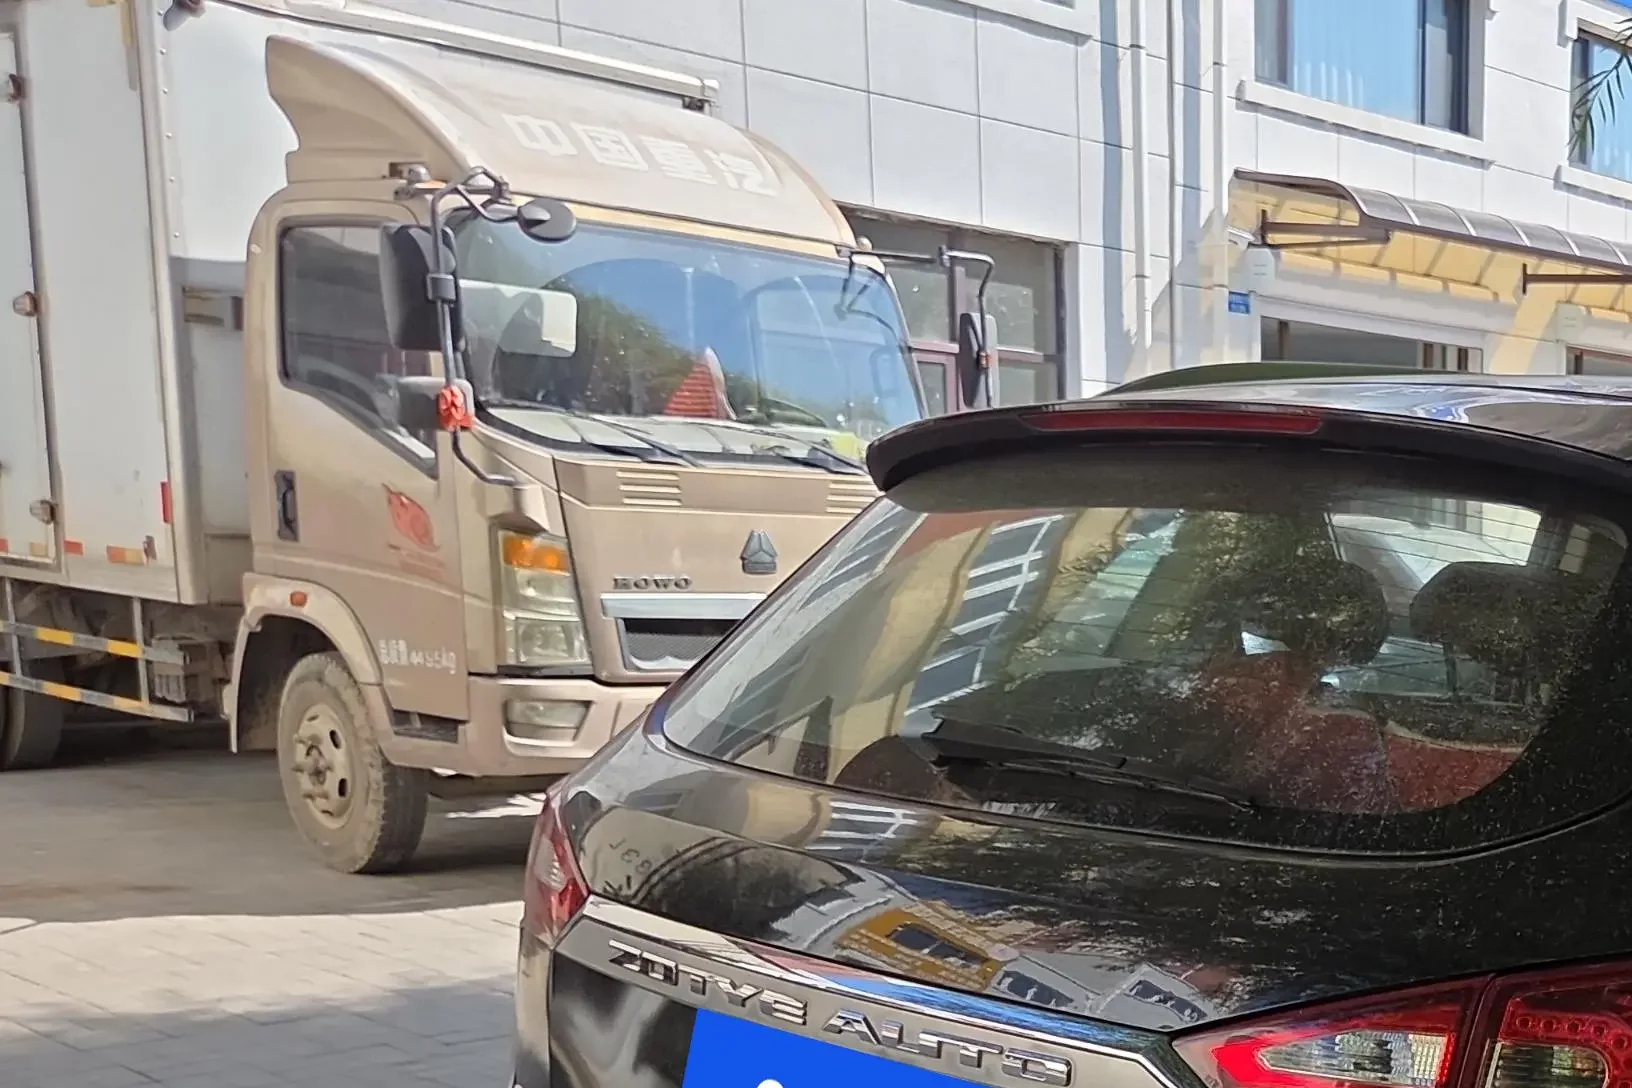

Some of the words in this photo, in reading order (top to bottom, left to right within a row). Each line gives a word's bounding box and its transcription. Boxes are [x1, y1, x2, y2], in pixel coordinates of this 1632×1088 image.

[503, 113, 779, 197] 中国重汽
[613, 576, 692, 590] HOWO
[608, 939, 808, 1026] ZOTYE
[823, 1007, 1072, 1088] AUTO
